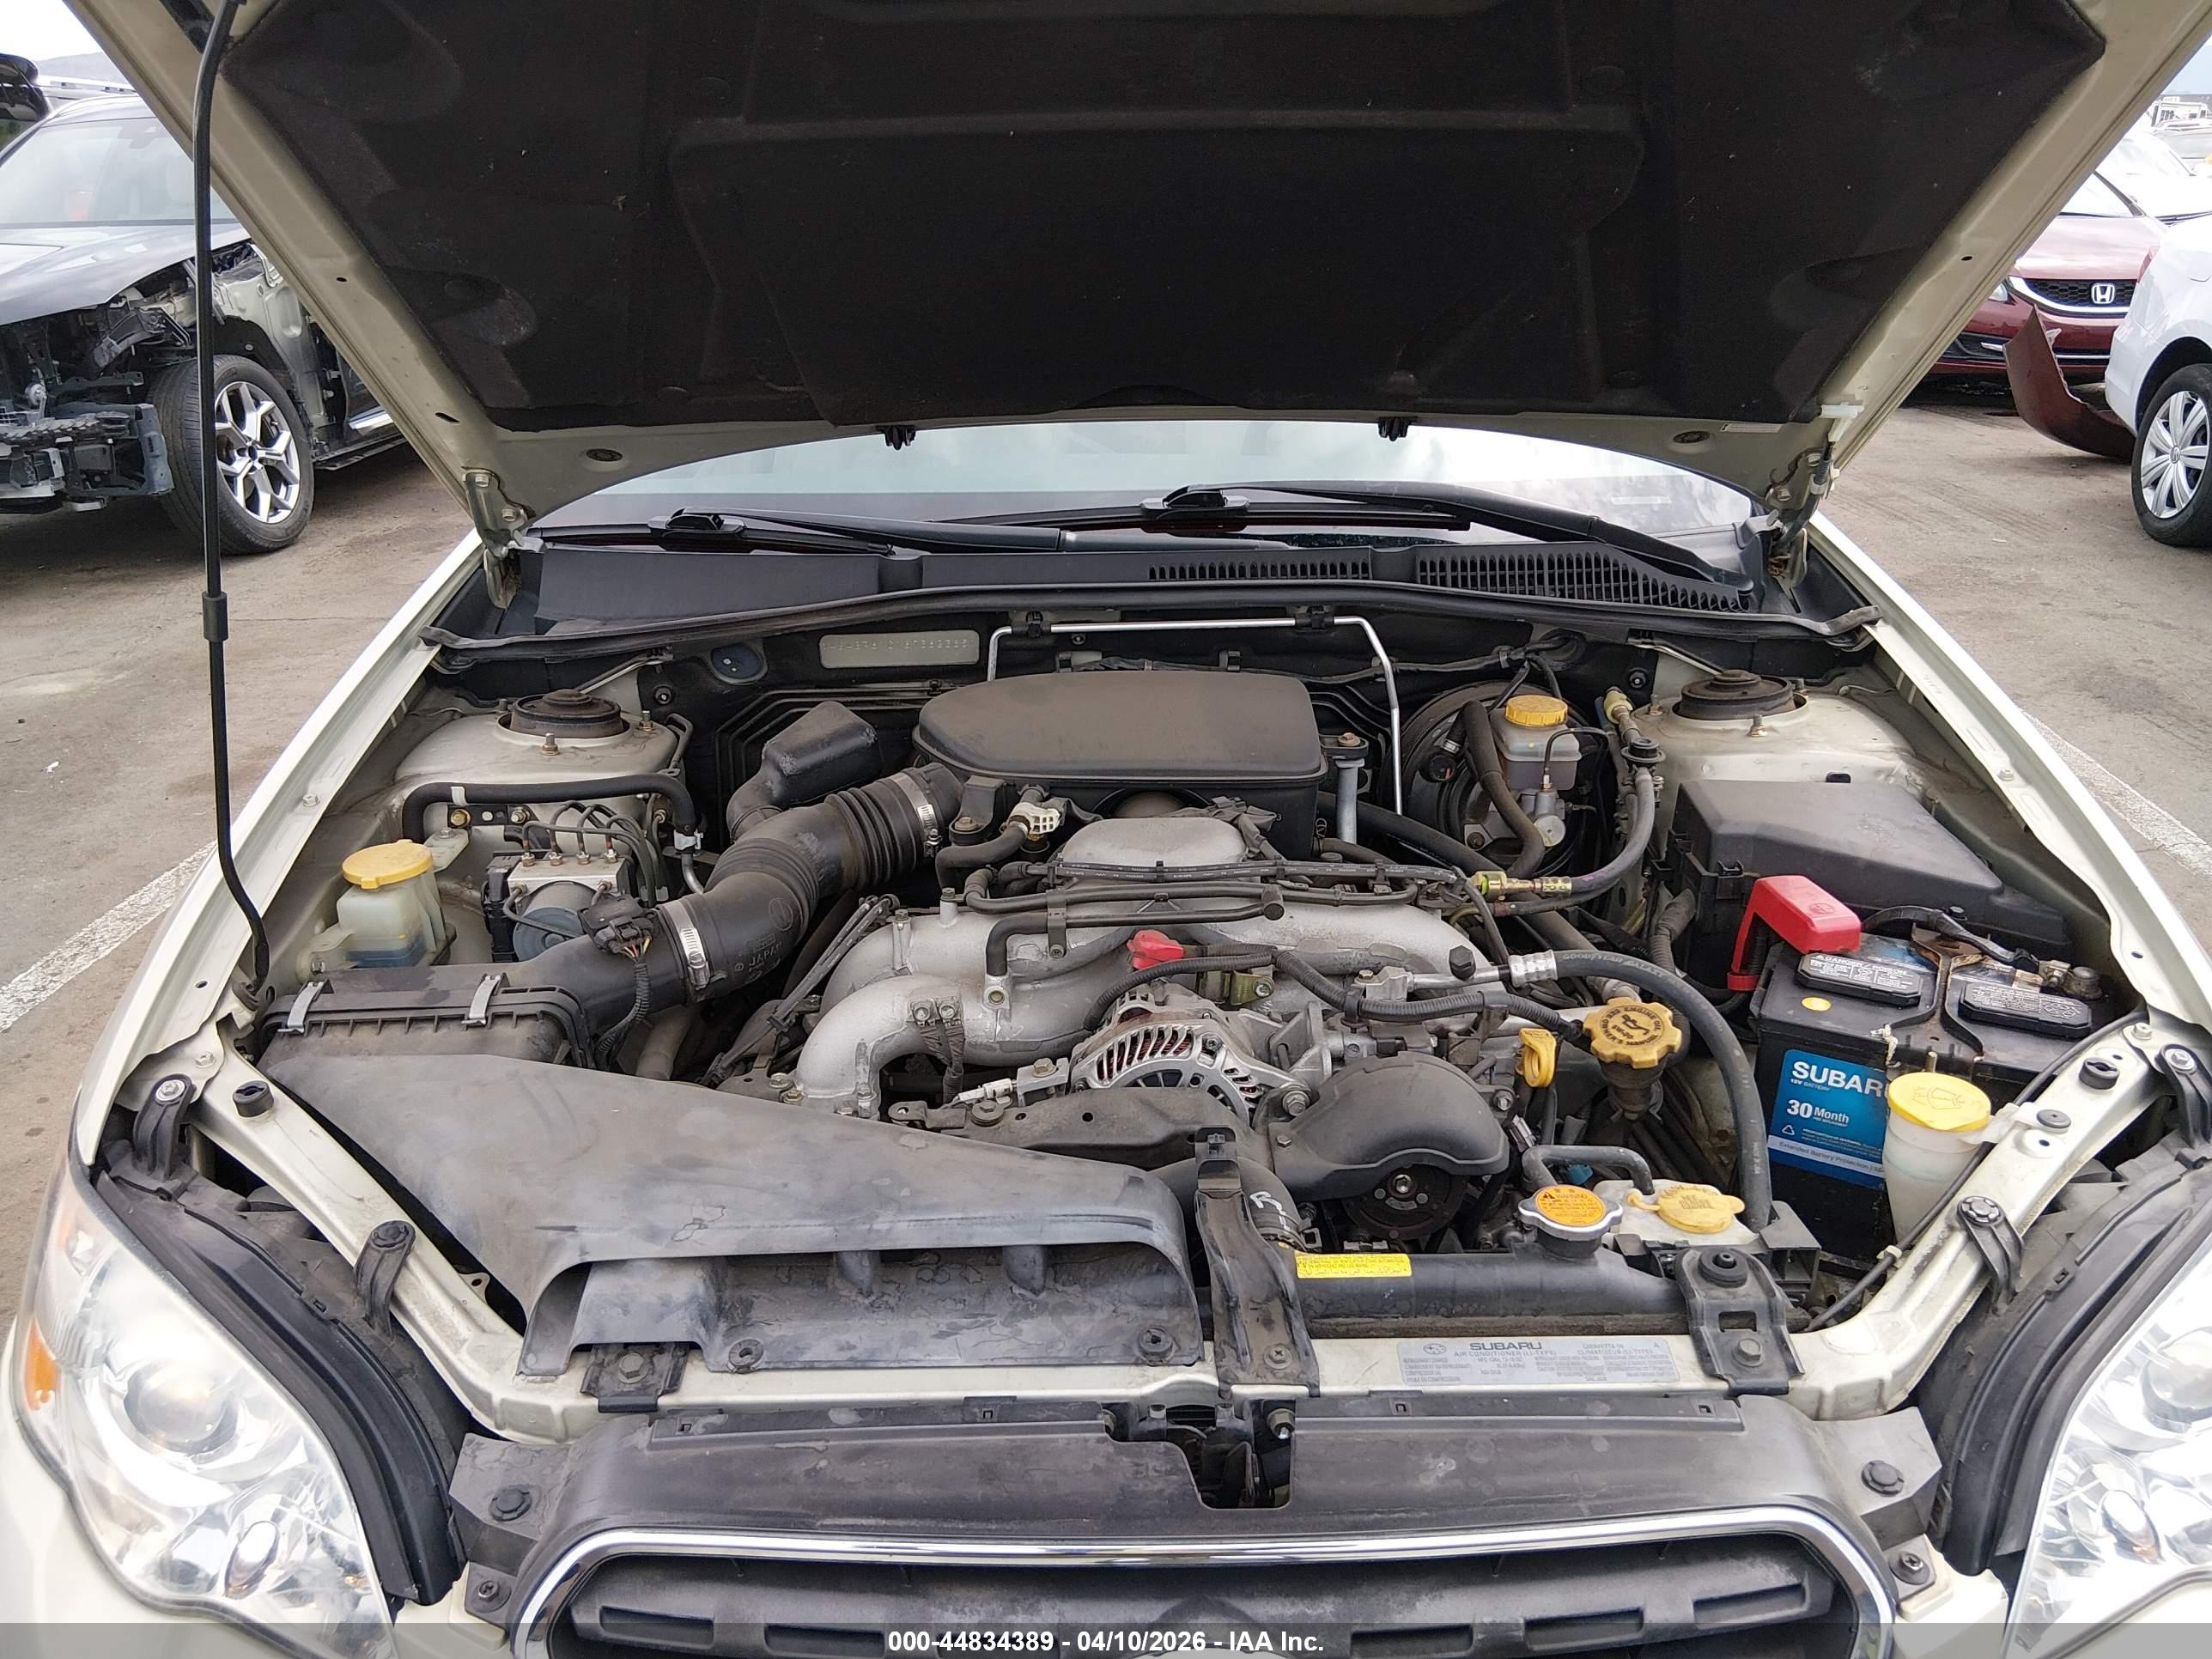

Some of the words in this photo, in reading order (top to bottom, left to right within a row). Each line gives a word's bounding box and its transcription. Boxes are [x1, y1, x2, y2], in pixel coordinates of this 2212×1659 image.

[1607, 1008, 1621, 1019] SEE
[1626, 1034, 1659, 1046] MANUAL
[1624, 1006, 1657, 1020] ENGINE
[1653, 1020, 1662, 1031] OIL
[1791, 1060, 1887, 1098] SUBAR
[1786, 1099, 1813, 1119] 30
[1814, 1106, 1850, 1124] Month
[1779, 1140, 1810, 1155] Extended
[1469, 1341, 1542, 1351] SUBARU
